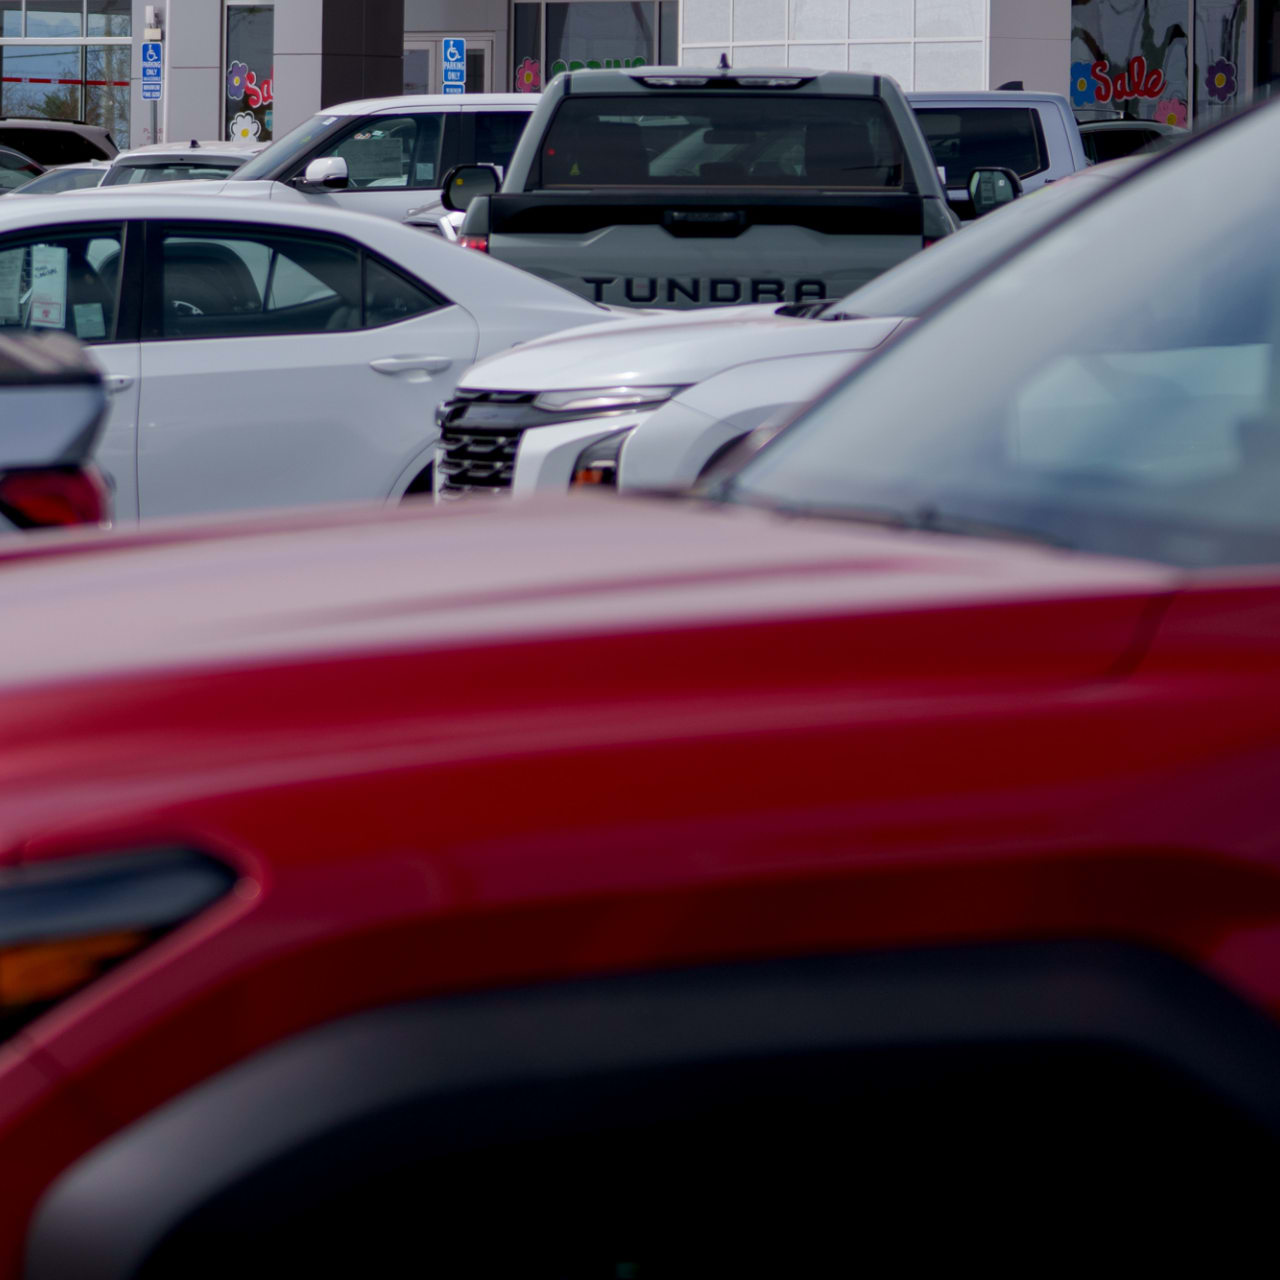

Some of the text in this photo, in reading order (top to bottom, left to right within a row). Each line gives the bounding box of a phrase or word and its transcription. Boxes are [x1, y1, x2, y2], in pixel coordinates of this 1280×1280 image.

[244, 67, 274, 108] Sa
[447, 71, 460, 80] ONLY
[1090, 56, 1167, 103] Sale
[582, 277, 827, 303] TUNDRA
